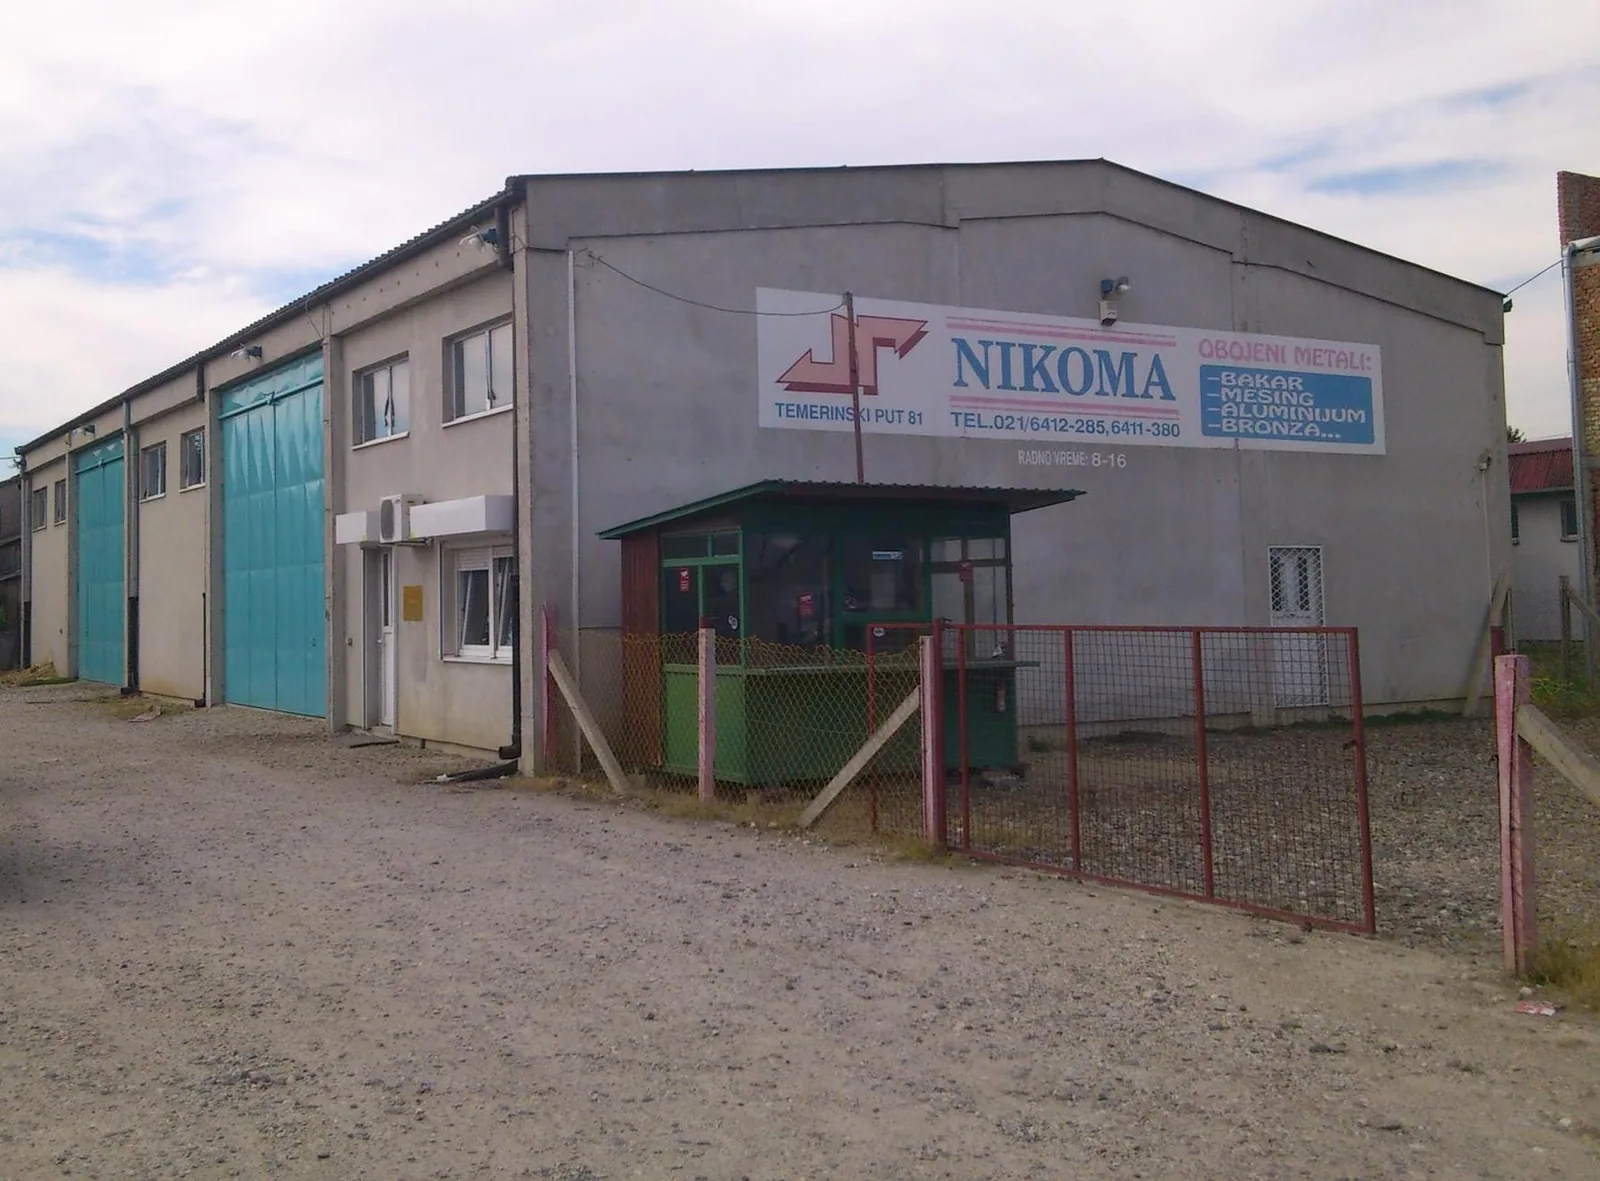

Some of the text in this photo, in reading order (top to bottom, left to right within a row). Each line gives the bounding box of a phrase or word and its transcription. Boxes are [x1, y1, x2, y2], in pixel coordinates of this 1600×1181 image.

[1198, 338, 1373, 371] OBOJENI METALI:
[951, 337, 1177, 402] NIKOMA
[875, 408, 905, 424] PUT
[908, 410, 923, 425] 81
[1018, 450, 1052, 466] RADNO
[1091, 452, 1127, 468] 8-16
